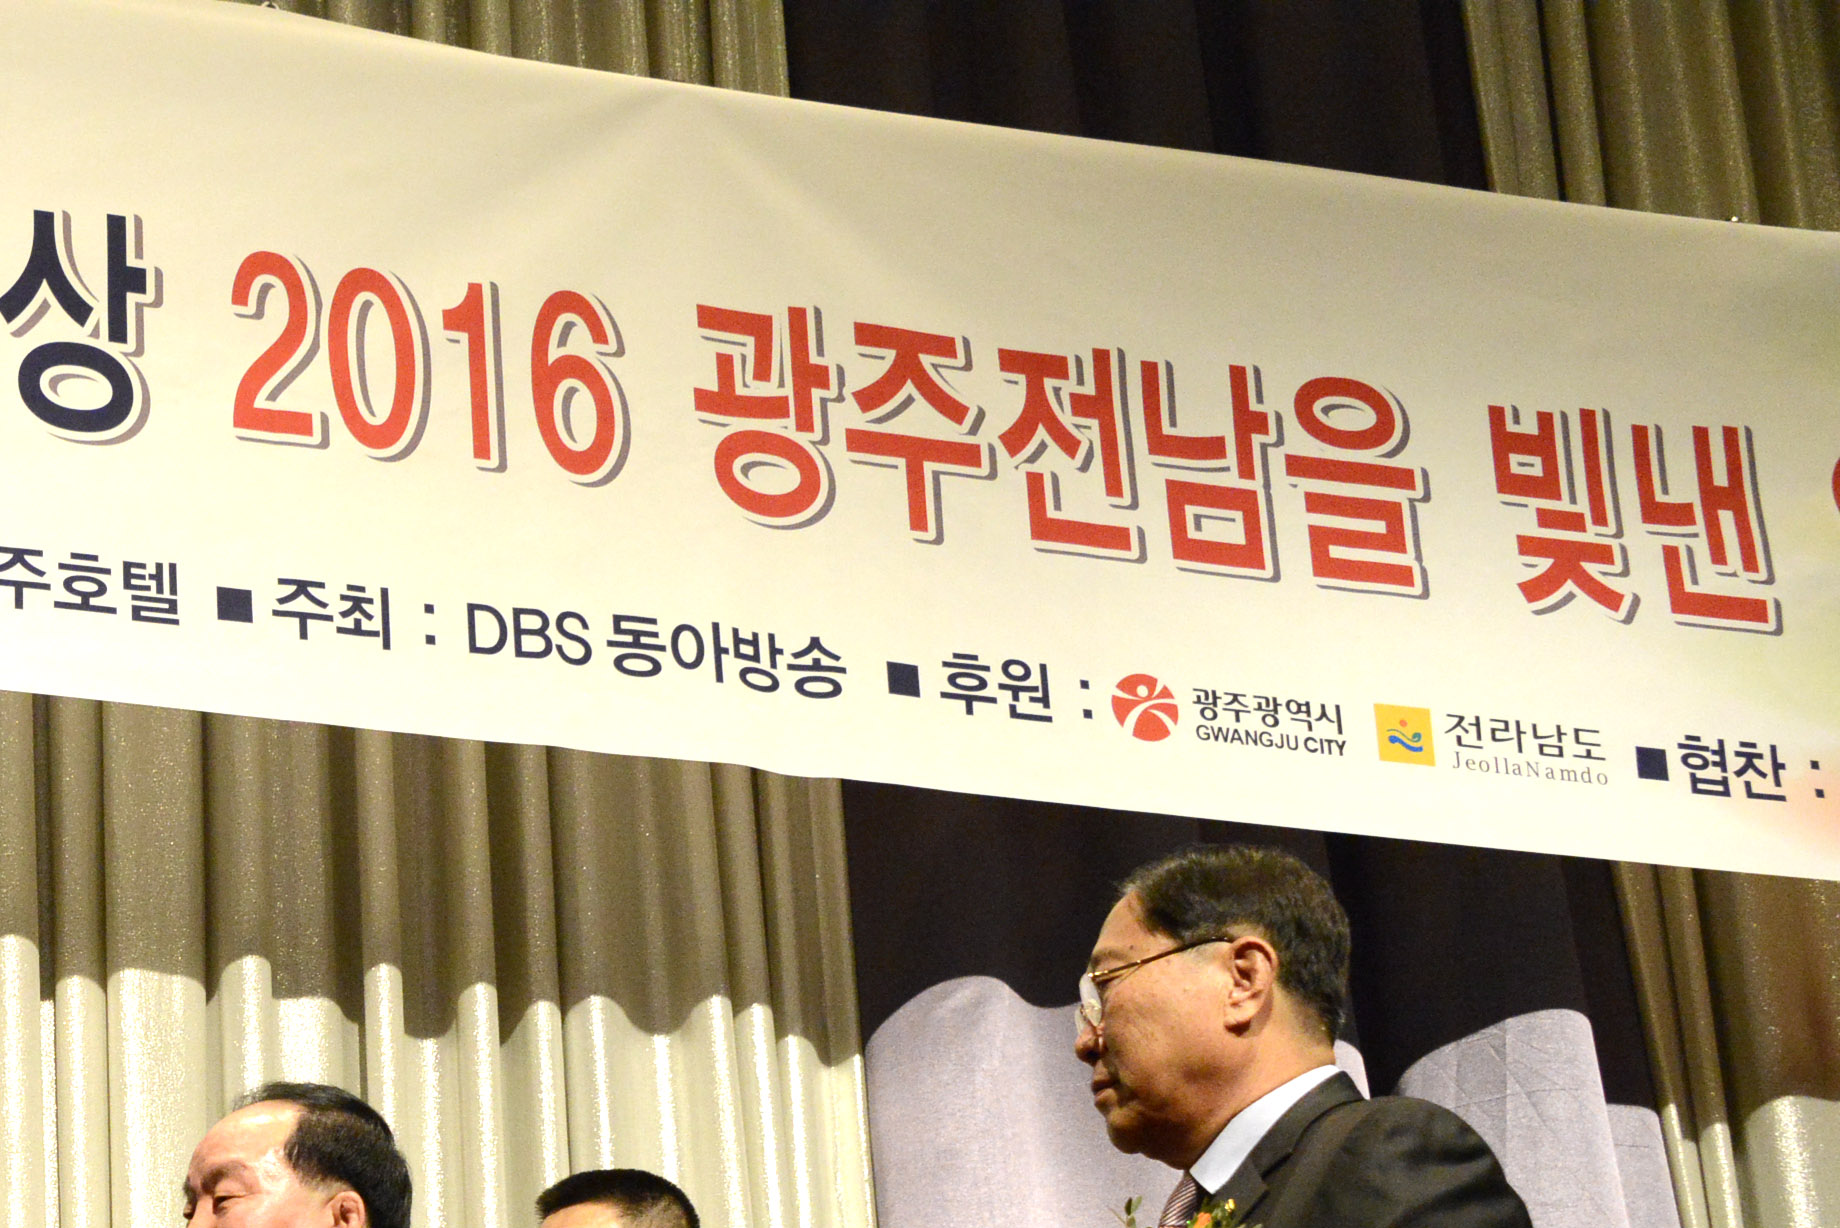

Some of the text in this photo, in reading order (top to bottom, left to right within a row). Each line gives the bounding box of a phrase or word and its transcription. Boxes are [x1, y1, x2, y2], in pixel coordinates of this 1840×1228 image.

[231, 251, 615, 475] 2016
[693, 304, 1416, 587] 광주전남을
[1488, 405, 1769, 624] 빛낸
[272, 578, 391, 650] 주최
[467, 603, 592, 666] DBS
[607, 614, 847, 699] 동아방송
[940, 653, 1053, 723] 후원
[1193, 688, 1343, 735] 광주광역시
[1196, 724, 1346, 756] GWANGJU CITY
[1445, 713, 1606, 761] 전라남도
[1451, 751, 1608, 785] JeollaNamdo
[1678, 735, 1786, 802] 협찬
